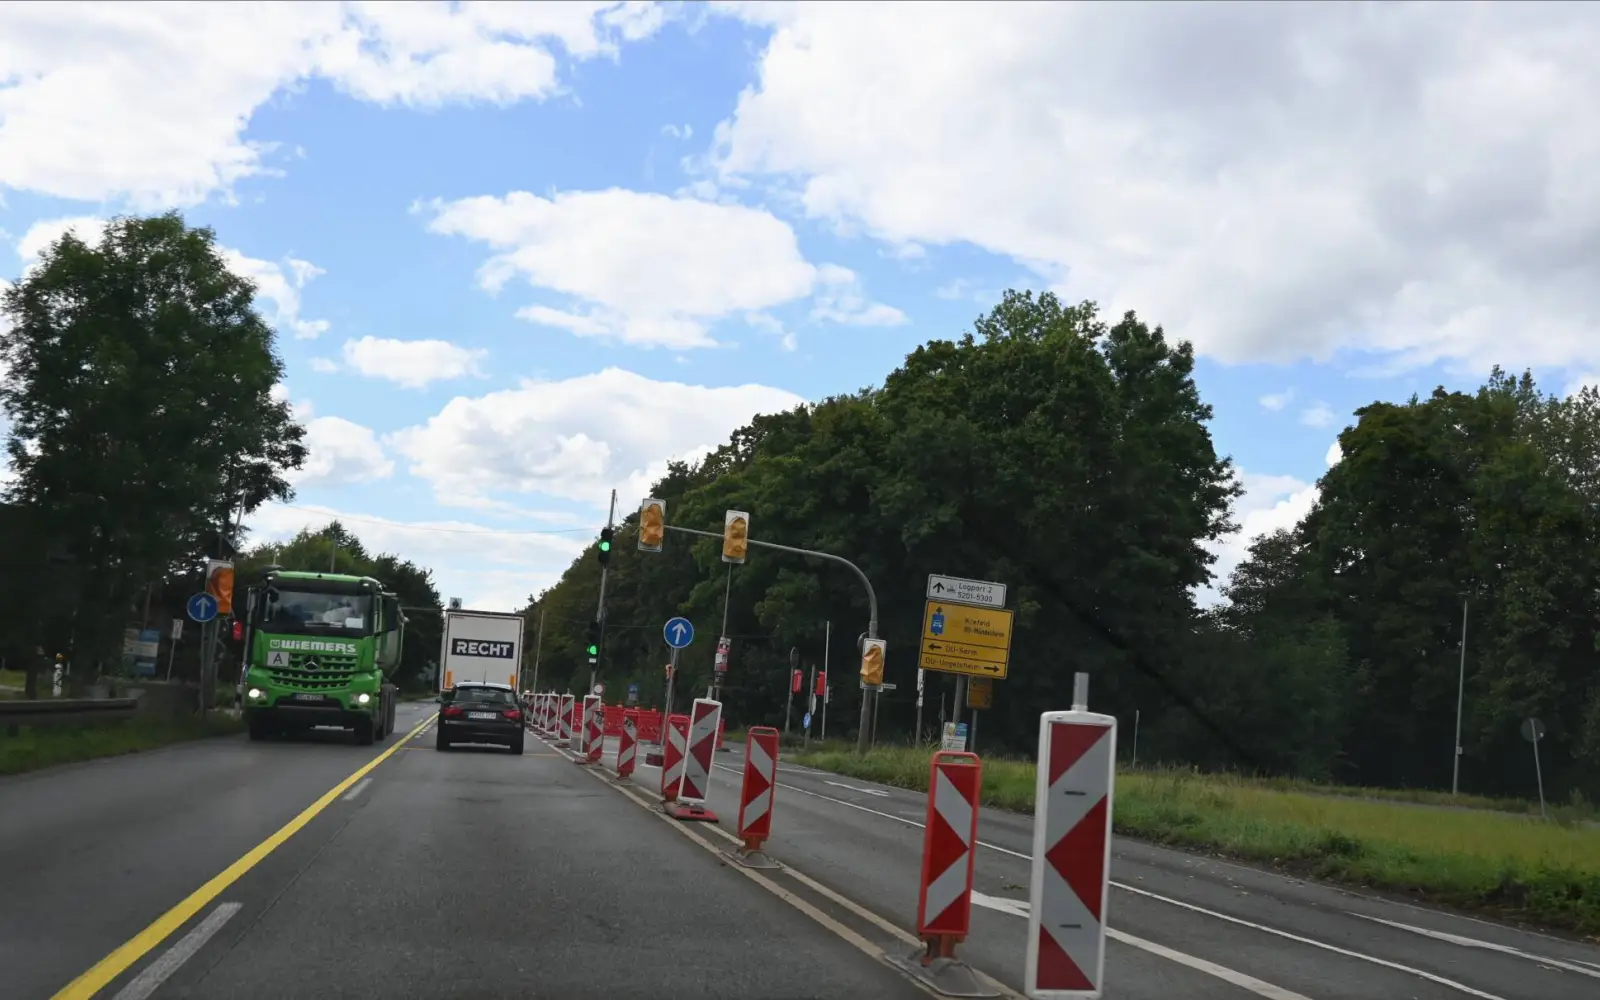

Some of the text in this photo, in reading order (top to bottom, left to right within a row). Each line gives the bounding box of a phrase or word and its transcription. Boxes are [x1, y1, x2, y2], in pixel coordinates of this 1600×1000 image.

[988, 586, 993, 594] 2
[456, 640, 510, 656] RECHT
[272, 652, 283, 665] A
